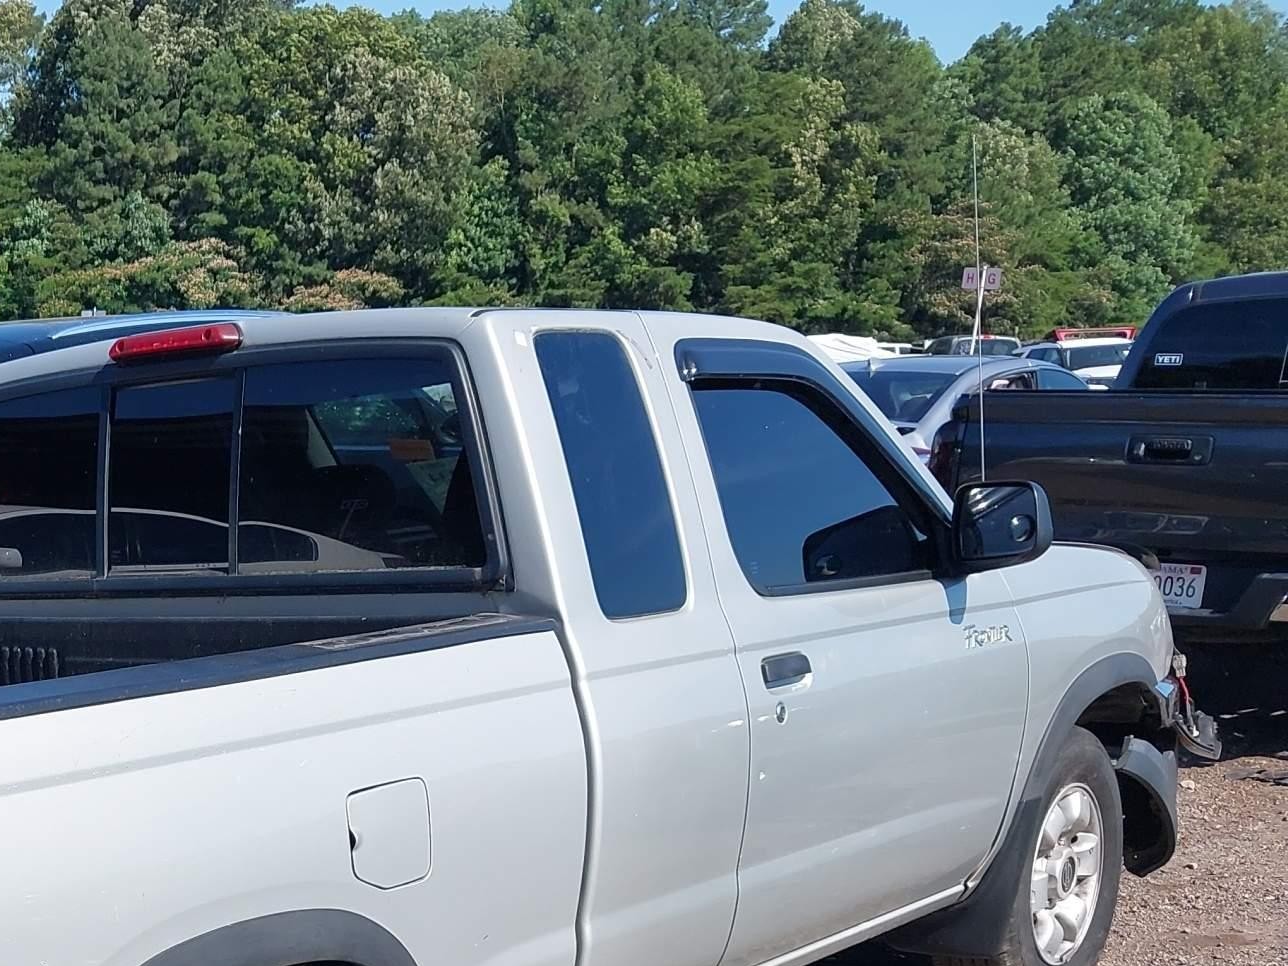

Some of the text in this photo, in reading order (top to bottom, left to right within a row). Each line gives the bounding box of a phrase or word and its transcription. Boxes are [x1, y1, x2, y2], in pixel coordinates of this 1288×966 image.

[966, 272, 975, 284] H
[987, 272, 997, 285] G
[1158, 355, 1180, 363] YETI
